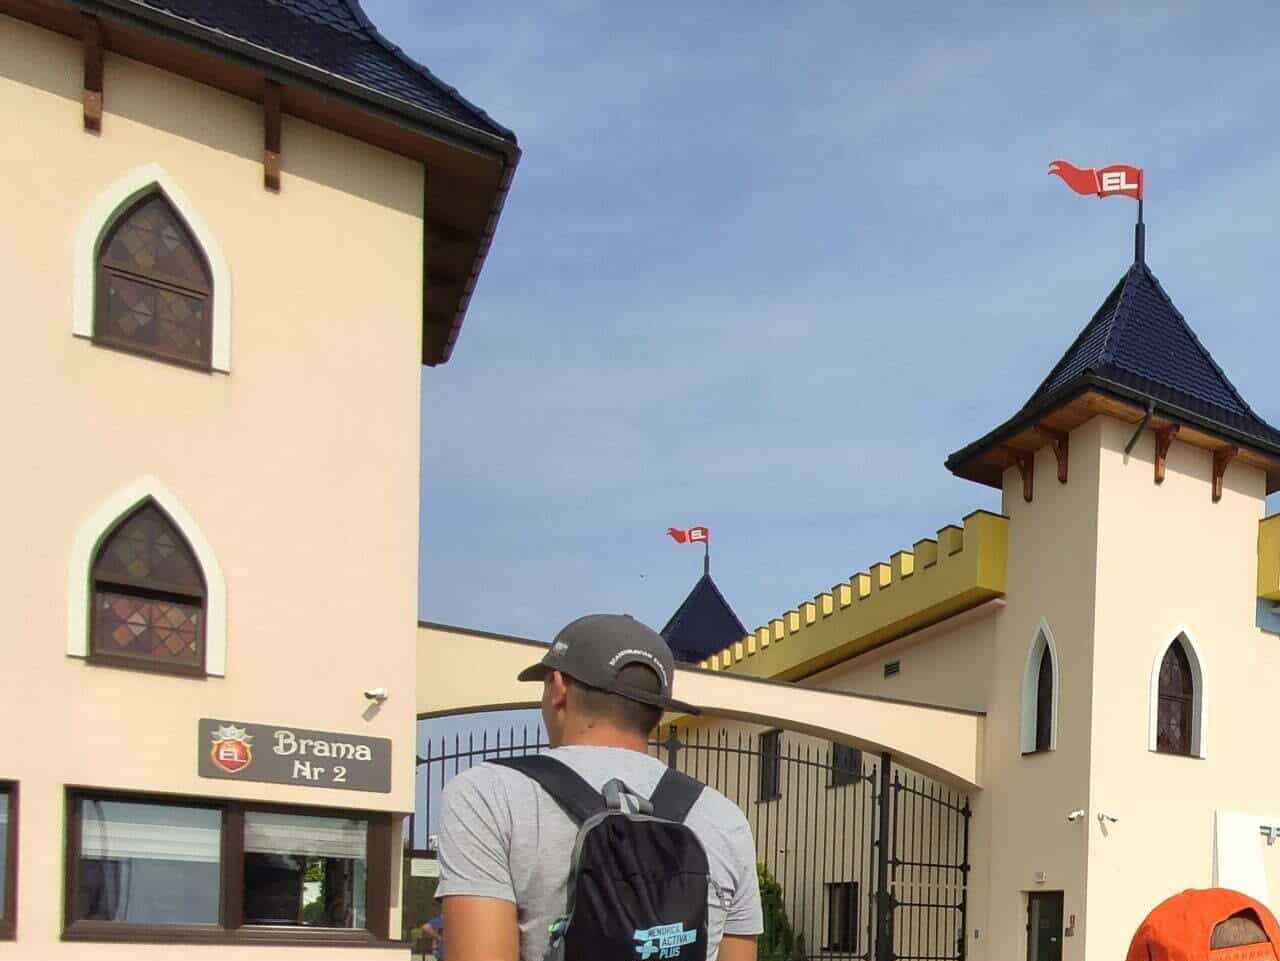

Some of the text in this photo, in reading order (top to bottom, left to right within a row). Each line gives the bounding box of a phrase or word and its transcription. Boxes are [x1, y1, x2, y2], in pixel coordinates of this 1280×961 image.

[1102, 171, 1139, 192] EL
[272, 729, 373, 761] Brama
[291, 760, 347, 783] Nr 2
[661, 934, 689, 947] ACTIVA
[659, 946, 681, 960] PLUS
